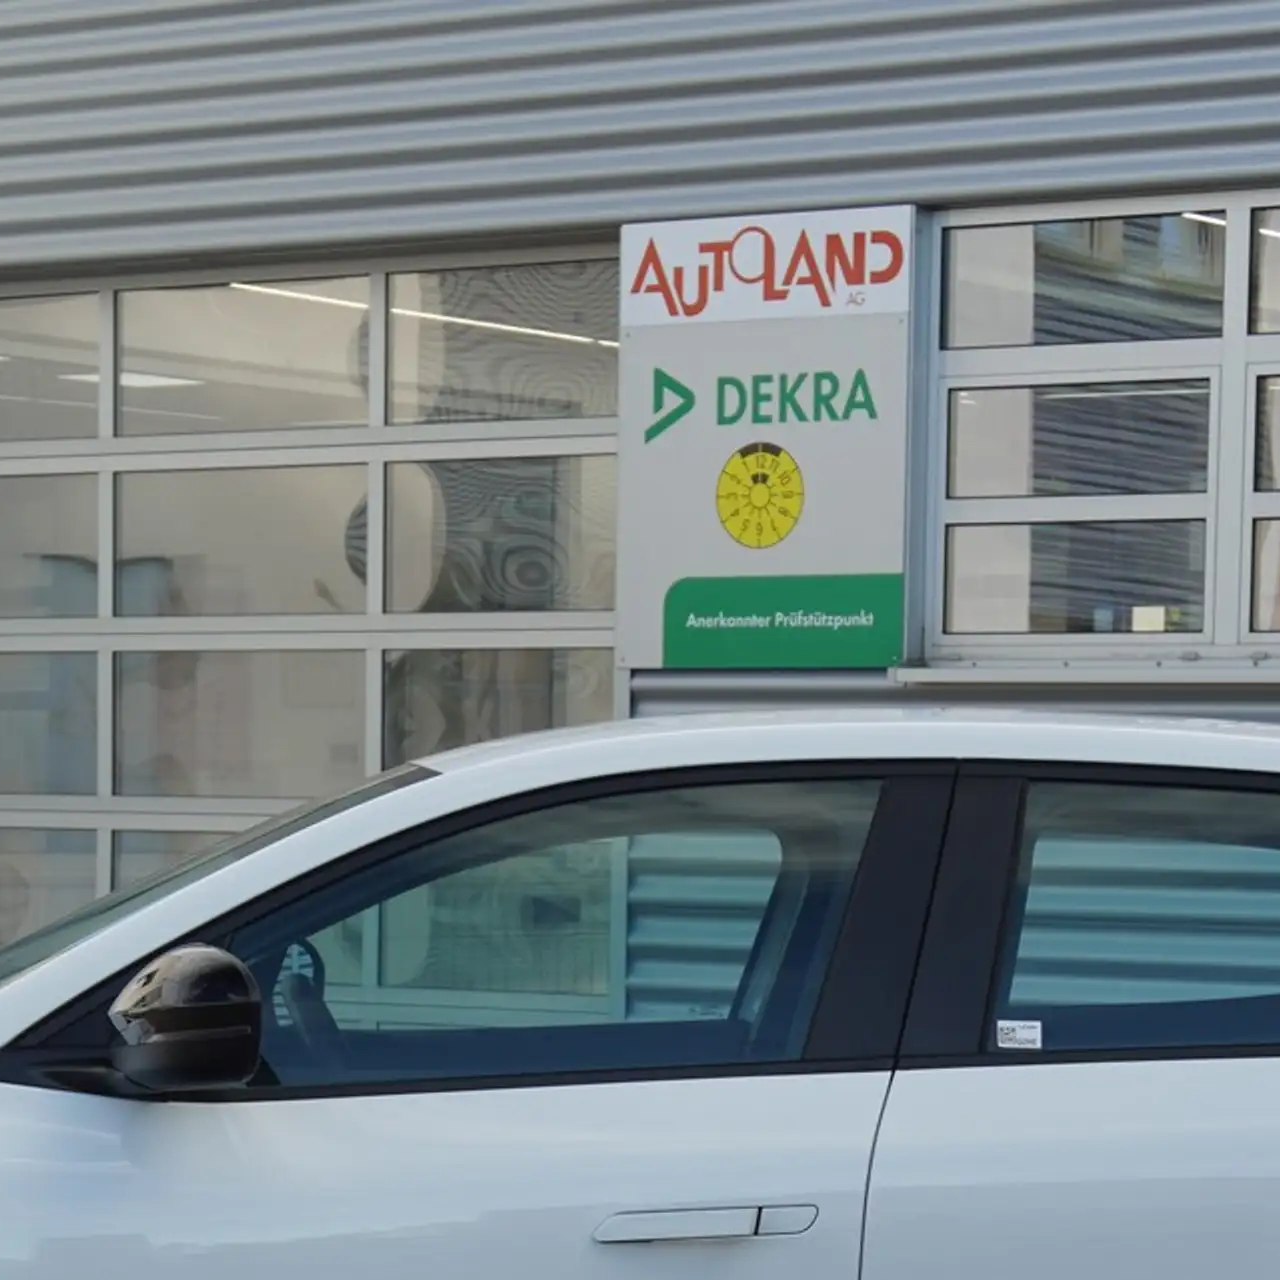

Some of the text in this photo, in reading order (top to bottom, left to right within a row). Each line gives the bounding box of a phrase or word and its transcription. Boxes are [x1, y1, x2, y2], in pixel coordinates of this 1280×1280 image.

[631, 226, 903, 317] AUTOLAND
[716, 368, 878, 426] DEKRA
[685, 608, 874, 630] Anerkannter Prüfstützpunkt
